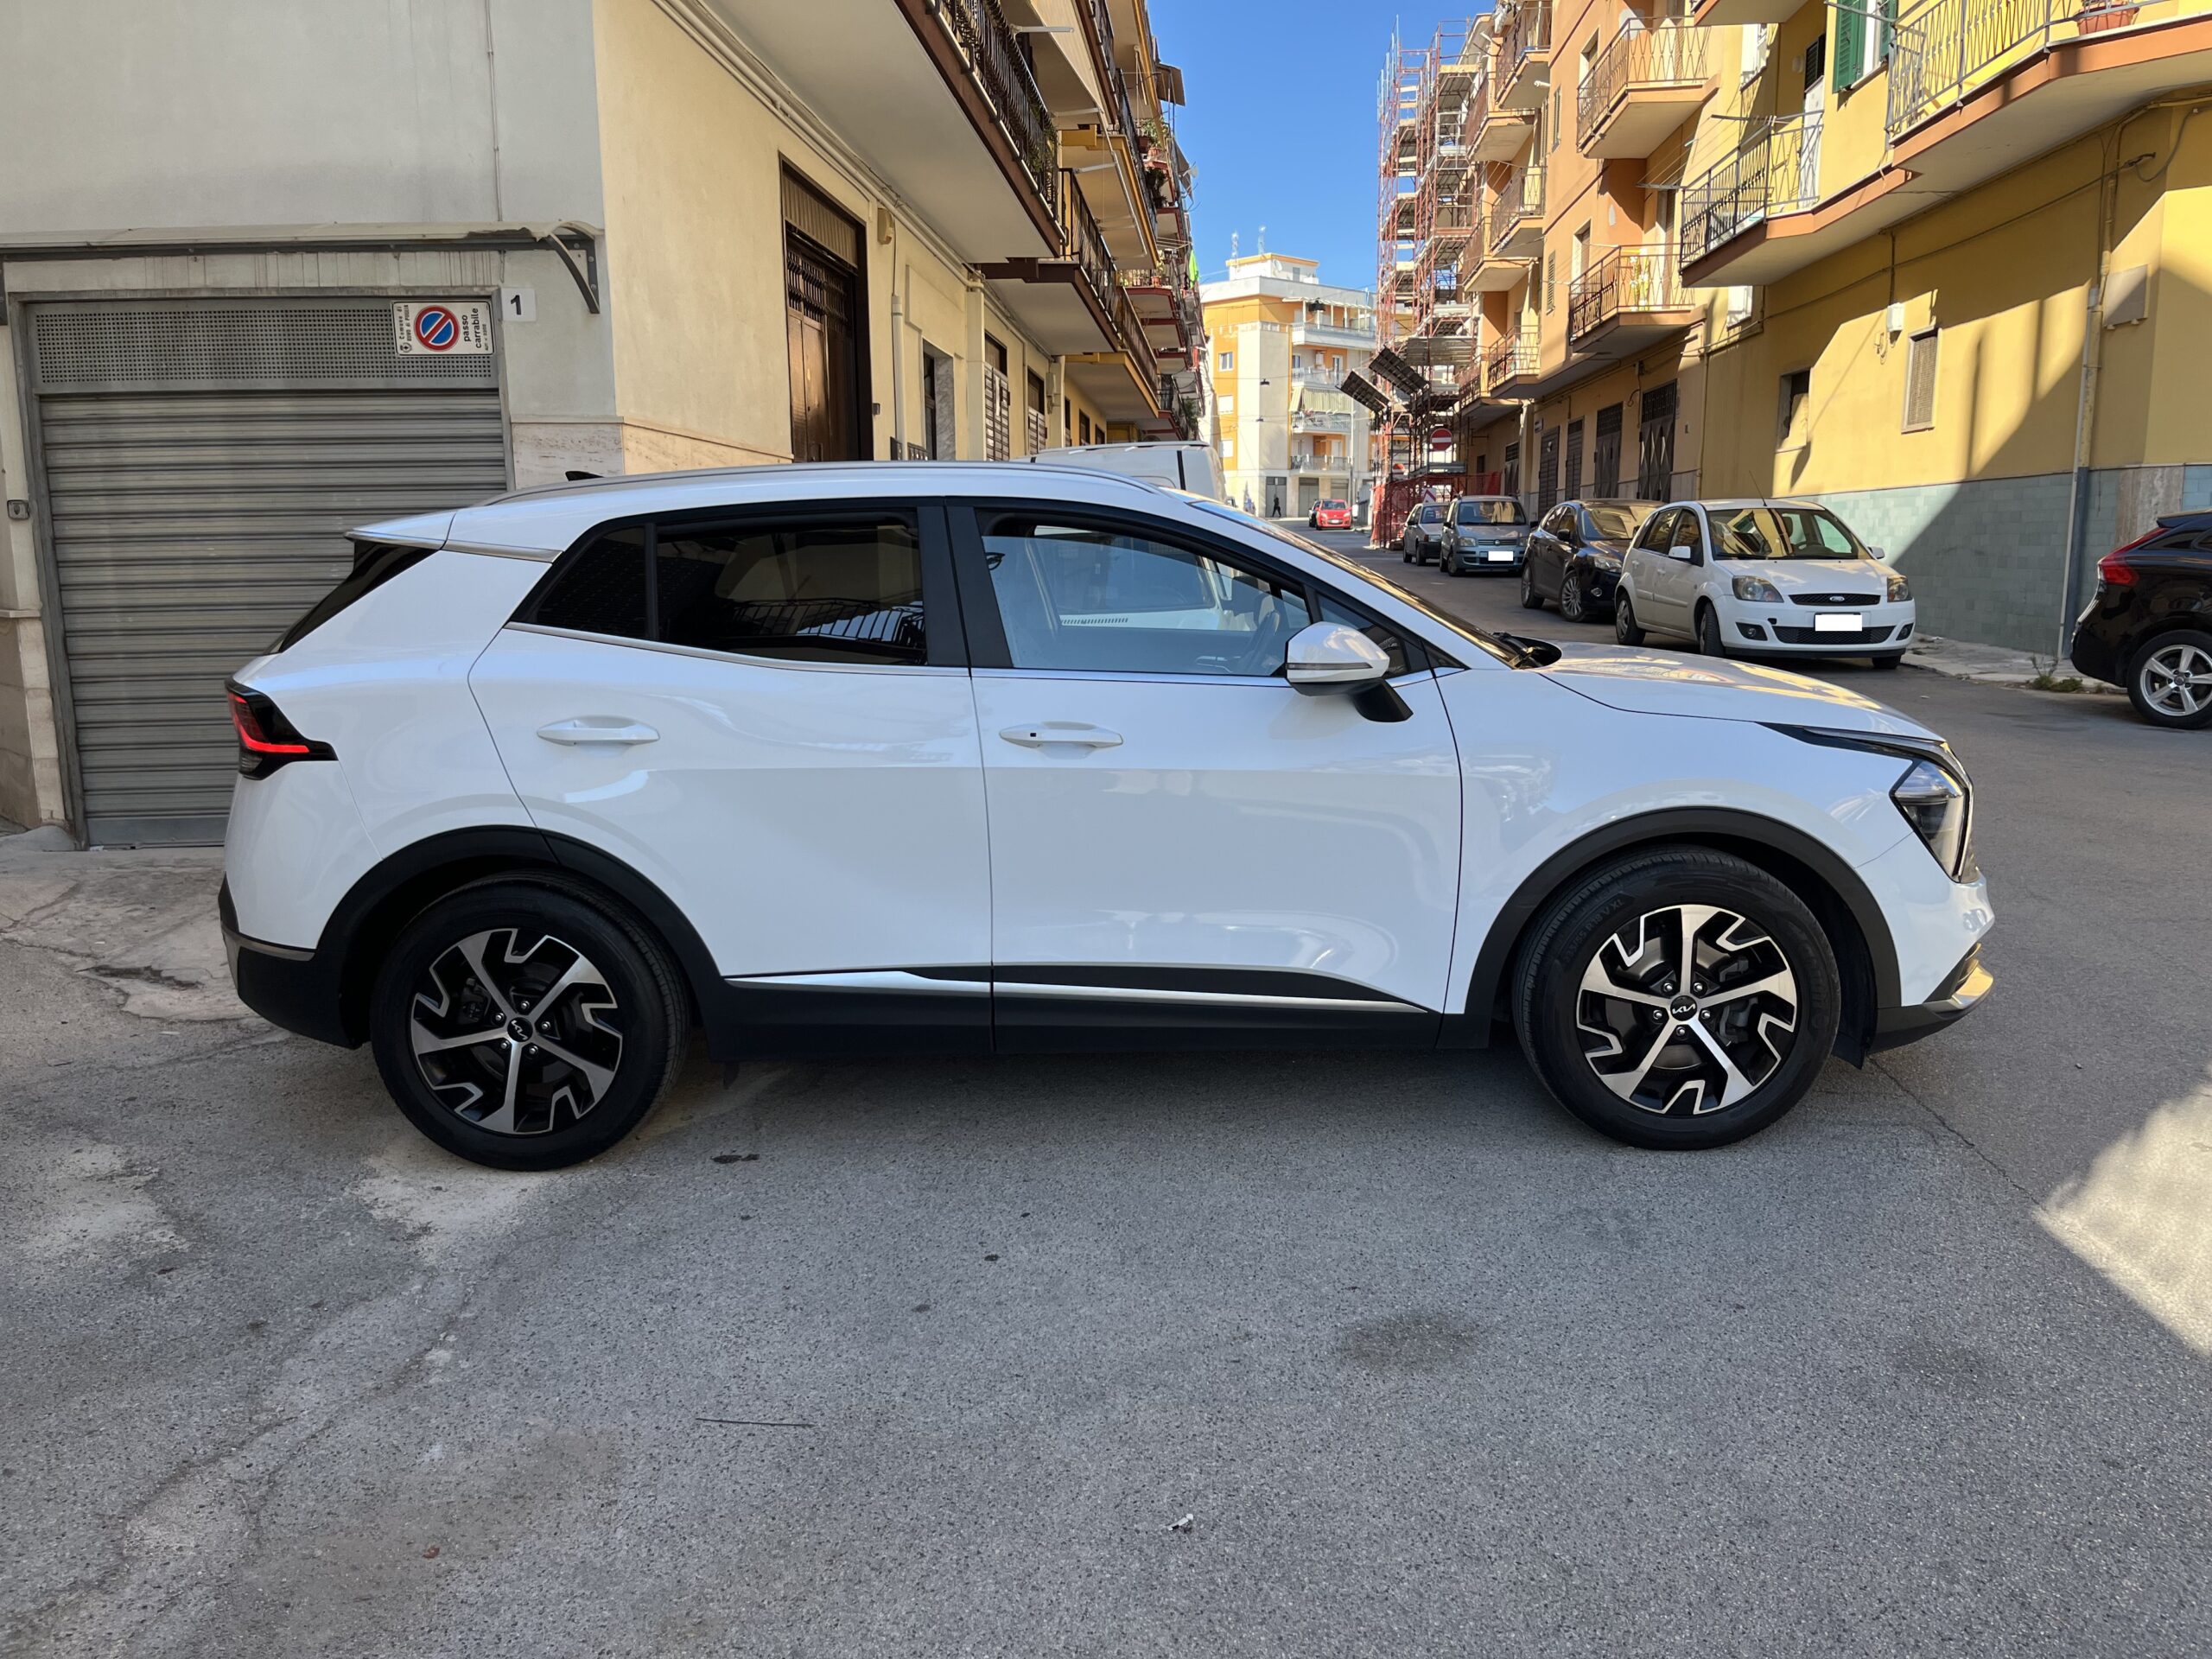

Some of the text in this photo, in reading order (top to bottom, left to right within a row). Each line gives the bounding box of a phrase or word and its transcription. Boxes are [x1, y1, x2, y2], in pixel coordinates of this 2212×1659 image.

[511, 295, 522, 315] 1
[461, 315, 471, 342] passo
[471, 308, 482, 348] carrabile
